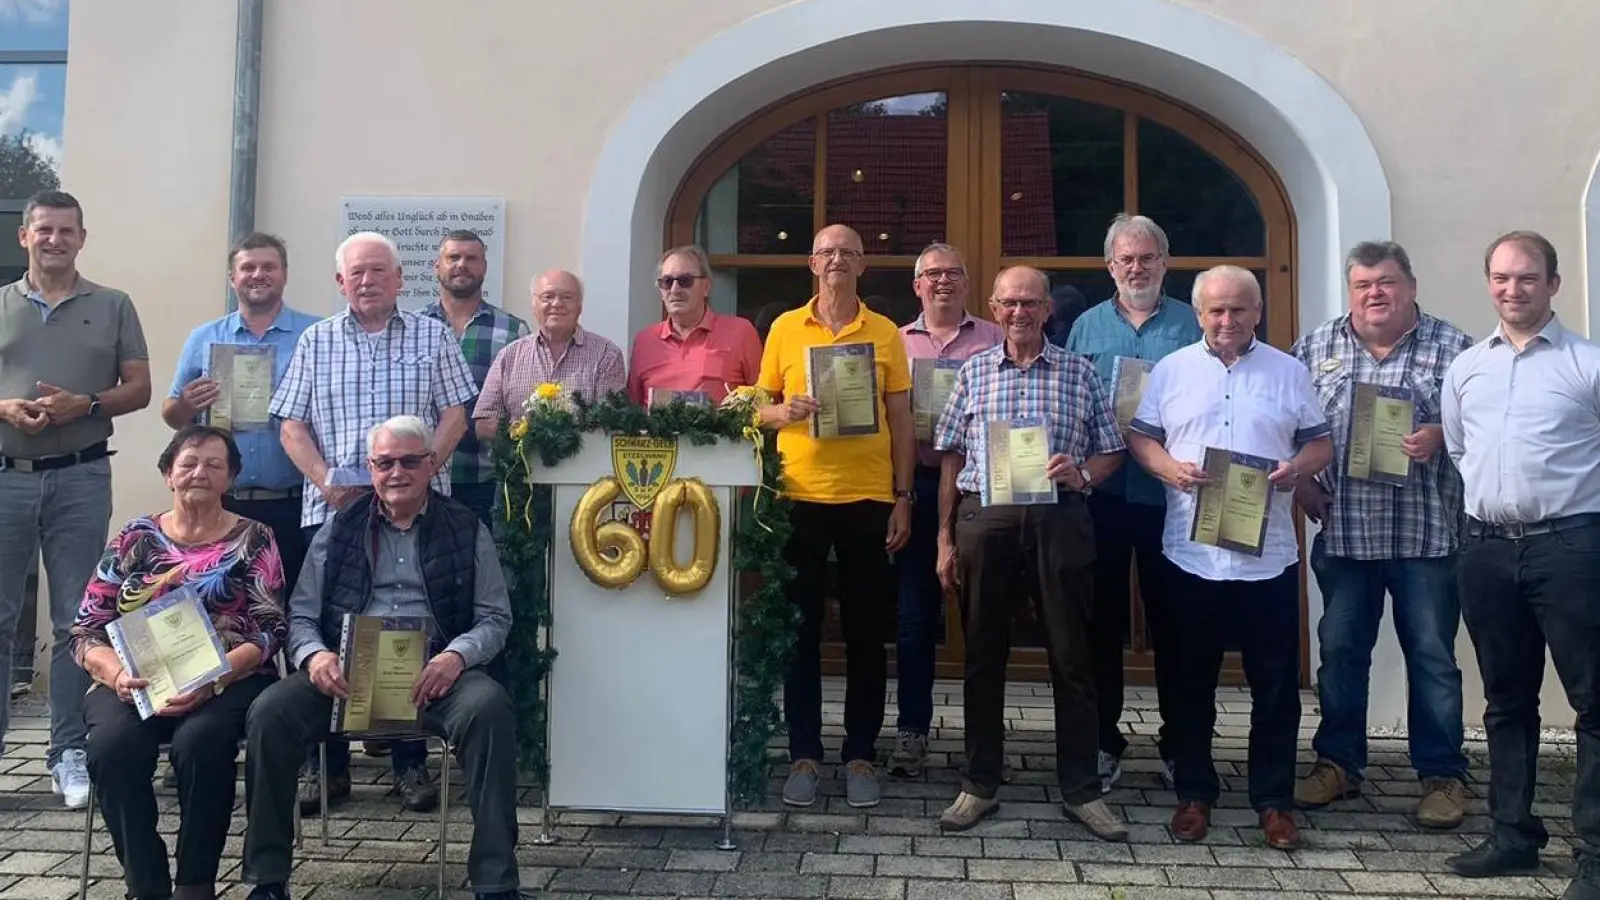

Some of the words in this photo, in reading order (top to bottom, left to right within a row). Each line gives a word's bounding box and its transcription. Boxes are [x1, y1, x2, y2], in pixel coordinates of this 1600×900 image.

[348, 211, 373, 221] Wend
[374, 211, 395, 221] alles
[436, 211, 448, 221] ab
[449, 212, 459, 221] in
[460, 211, 495, 222] Gnaden
[391, 227, 413, 237] Gott
[414, 227, 439, 237] durch
[401, 259, 426, 267] unser
[403, 273, 419, 281] wir
[419, 271, 434, 282] die
[614, 438, 675, 448] SCHWARZ-GELB
[623, 451, 667, 460] ETZELWANG
[569, 476, 721, 595] 60
